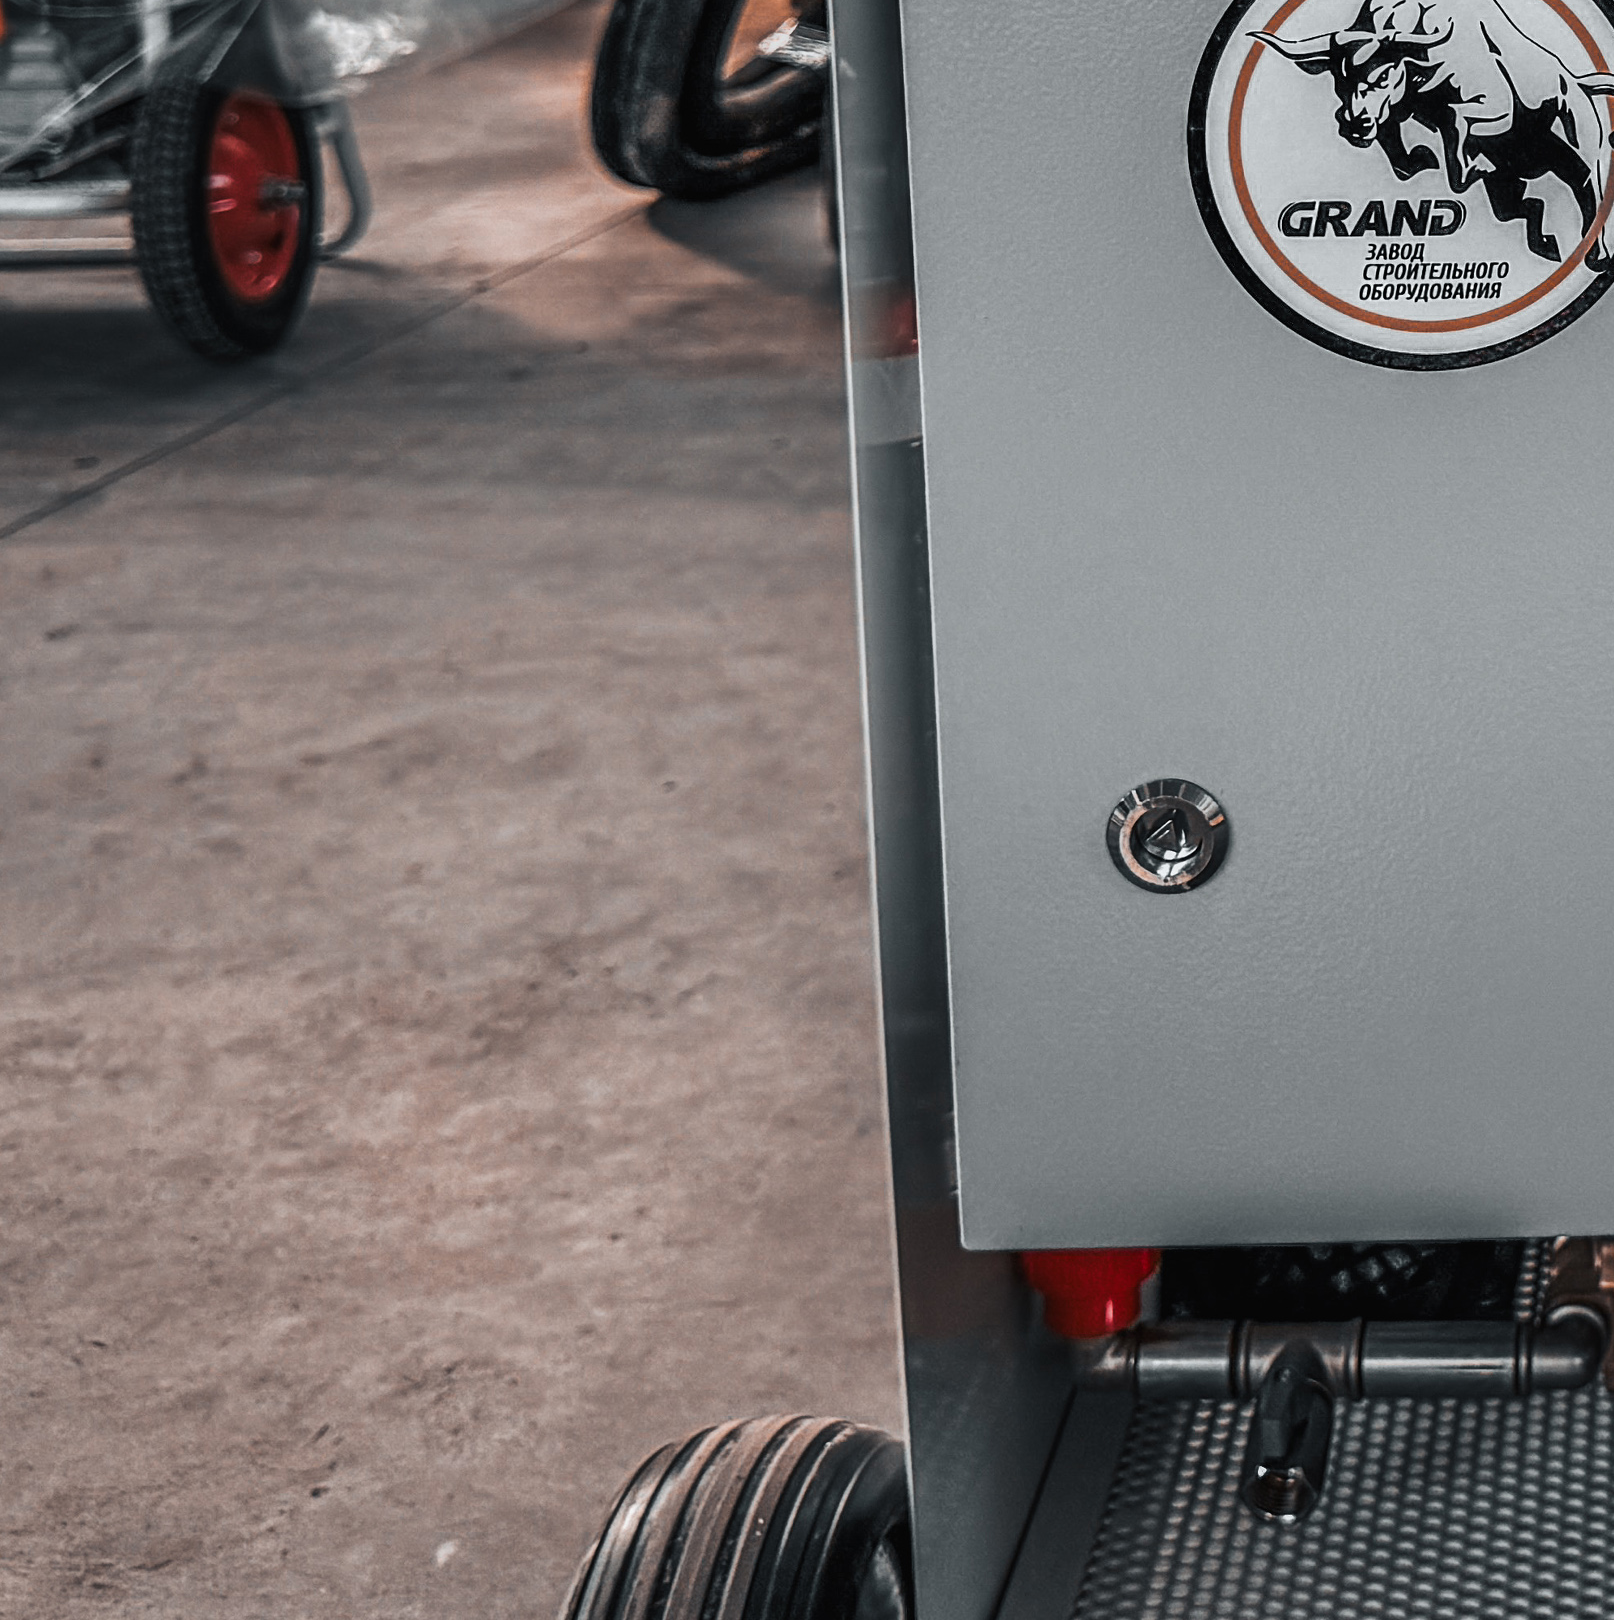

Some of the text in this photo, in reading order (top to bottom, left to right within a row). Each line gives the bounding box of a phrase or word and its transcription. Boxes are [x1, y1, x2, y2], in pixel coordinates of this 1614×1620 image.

[1278, 199, 1467, 238] GRAND
[1365, 243, 1426, 263] ЗАВОД
[1363, 262, 1509, 280] СТРОИТЕЛЬНОГО
[1359, 282, 1502, 302] ОБОРУДОВАНИЯ
